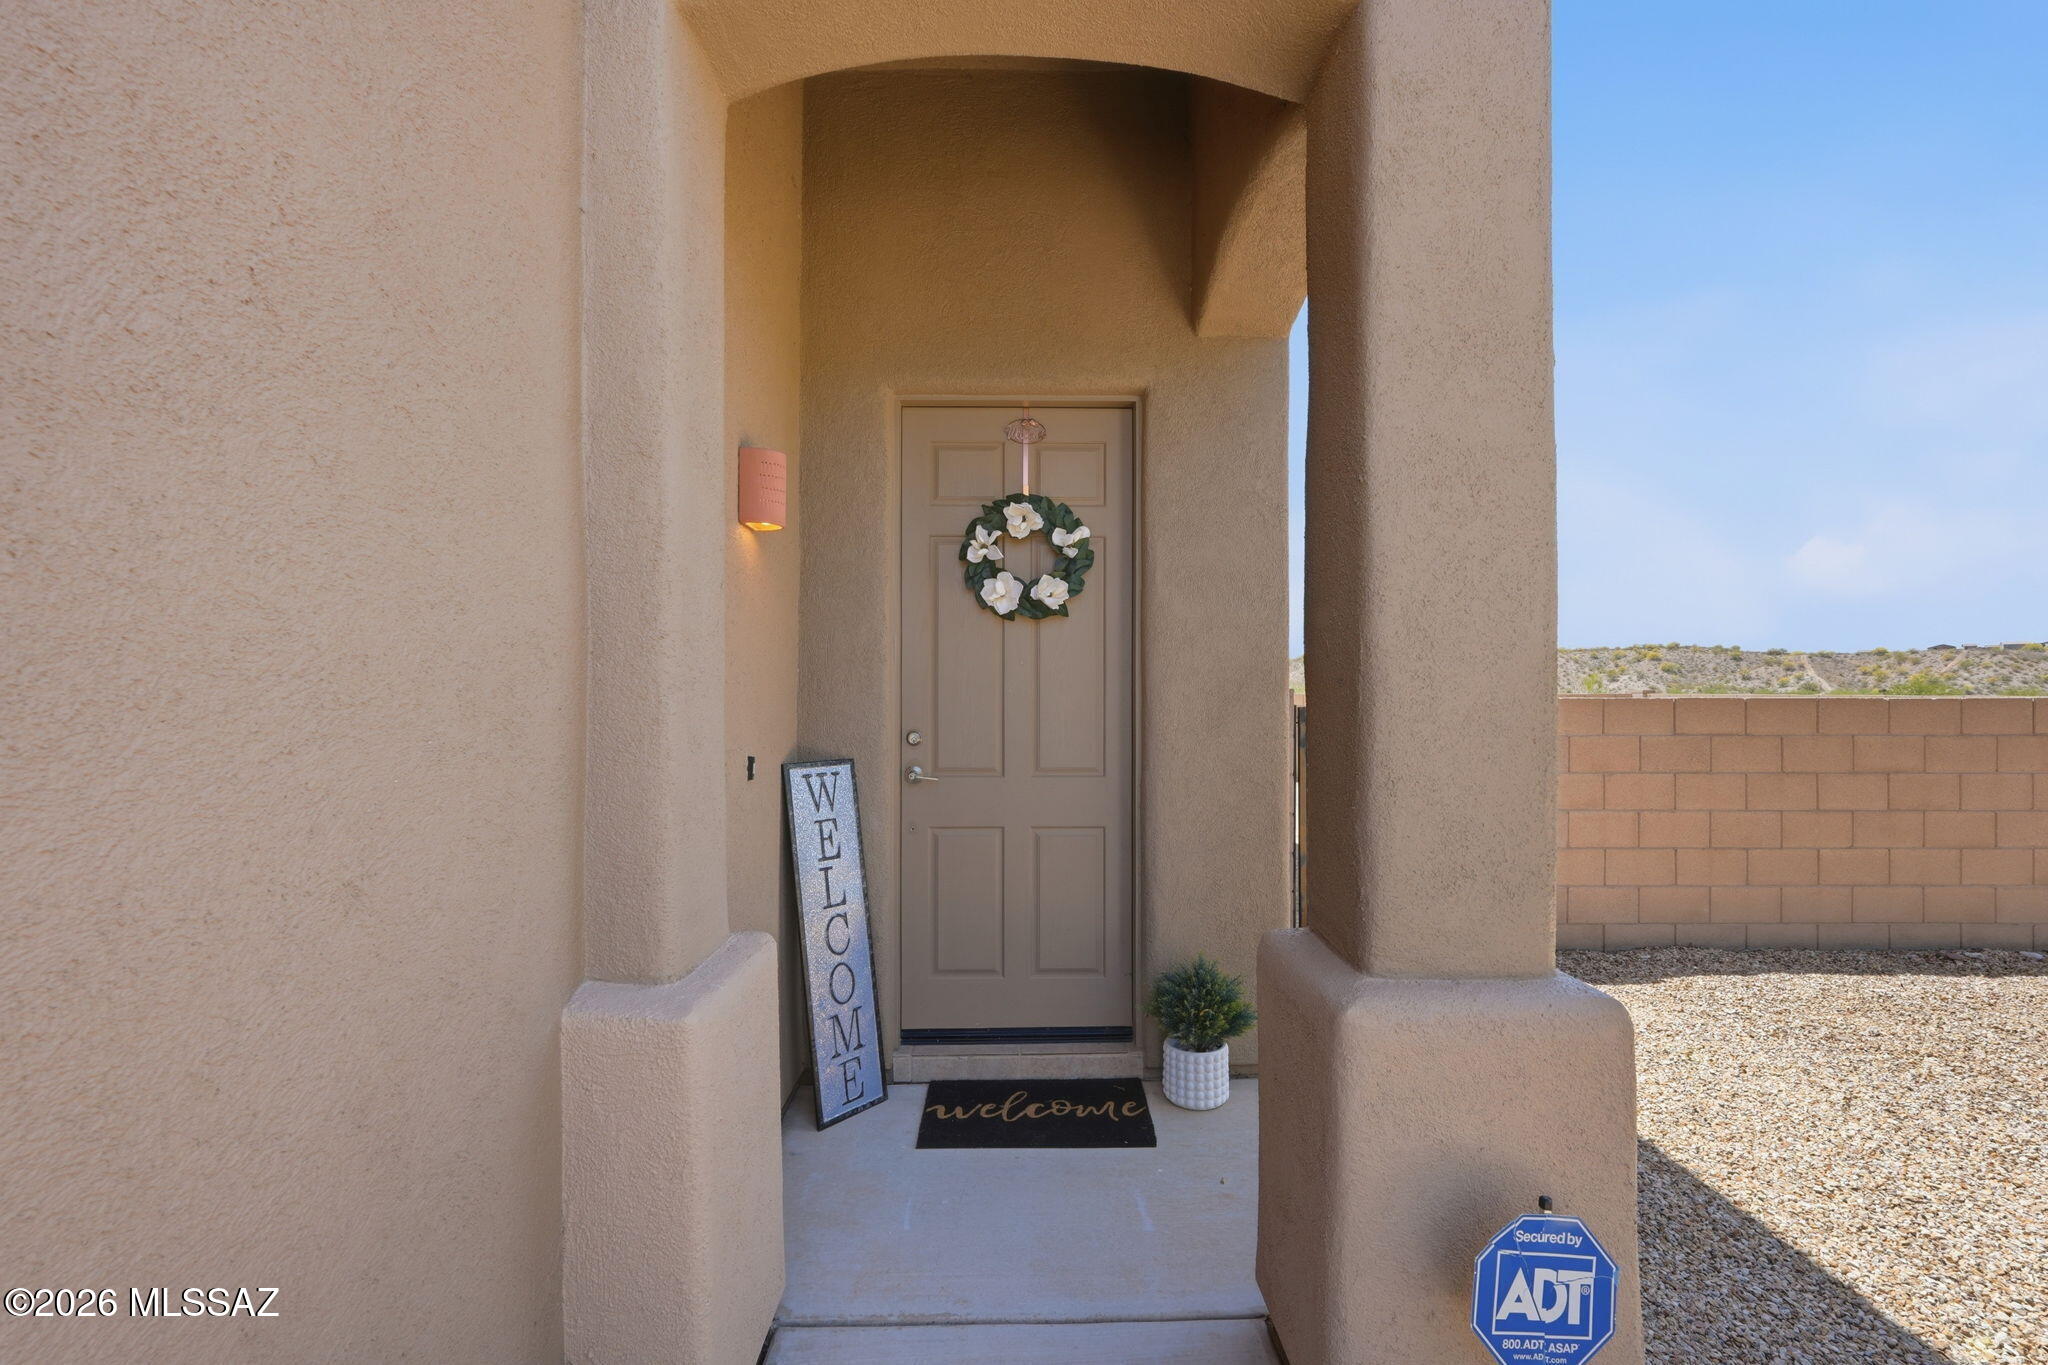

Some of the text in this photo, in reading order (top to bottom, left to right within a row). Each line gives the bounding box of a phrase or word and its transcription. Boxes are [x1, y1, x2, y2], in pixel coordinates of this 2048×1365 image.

[802, 771, 864, 1105] WELCOME
[926, 1091, 1148, 1122] welcome
[1515, 1230, 1583, 1248] Secured by
